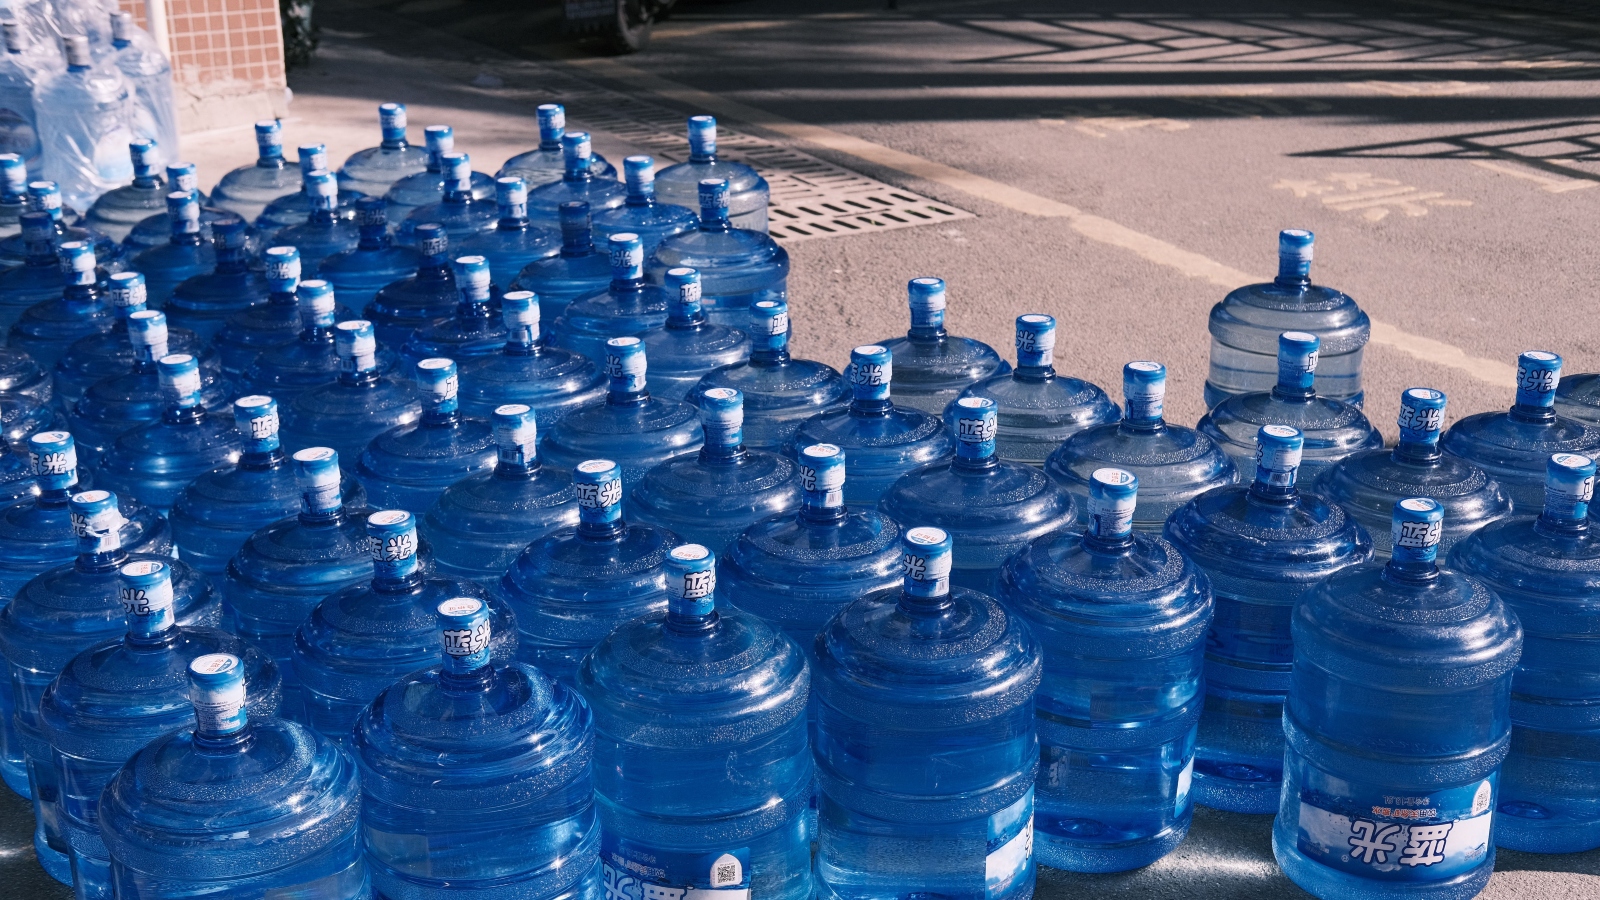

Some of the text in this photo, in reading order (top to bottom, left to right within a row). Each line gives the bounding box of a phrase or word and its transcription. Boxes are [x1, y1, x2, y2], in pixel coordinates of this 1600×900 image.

[1397, 403, 1440, 431] 蓝光
[576, 479, 622, 508] 蓝光
[367, 534, 411, 560] 蓝光
[443, 618, 491, 656] 蓝光
[1348, 820, 1454, 867] 蓝光
